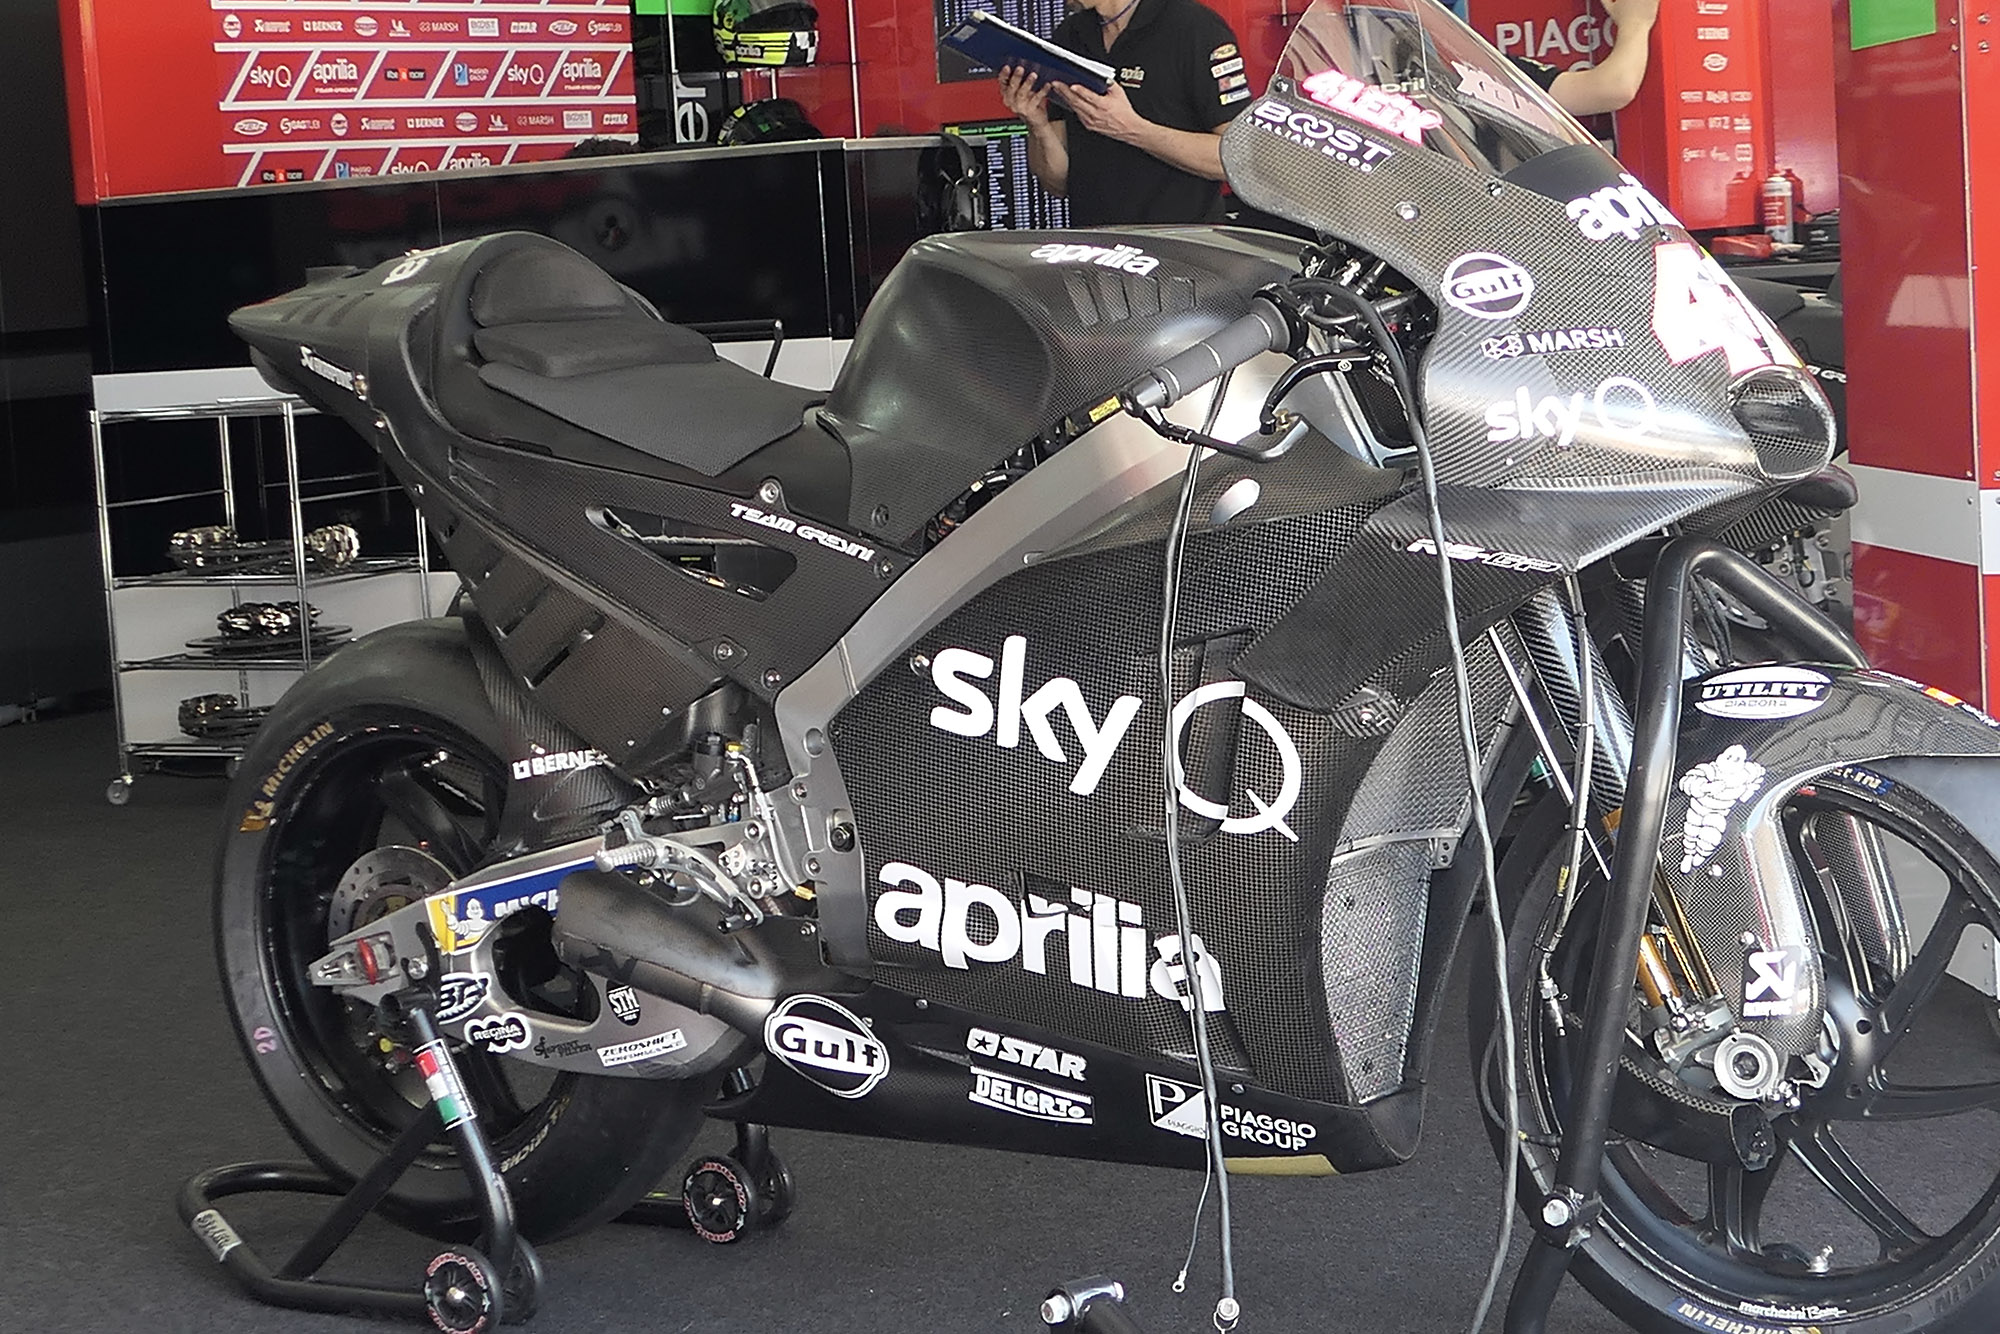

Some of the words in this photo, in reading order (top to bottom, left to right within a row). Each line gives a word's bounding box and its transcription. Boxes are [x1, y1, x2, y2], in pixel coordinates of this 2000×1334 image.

[431, 21, 459, 32] MARSH
[250, 65, 275, 88] sky
[275, 65, 292, 87] Q
[313, 58, 358, 84] aprilia
[507, 66, 529, 85] sky
[529, 64, 544, 85] Q
[562, 58, 602, 82] aprilia
[1246, 115, 1316, 148] ITALIAN
[1254, 100, 1393, 161] BOOST
[1030, 243, 1160, 277] aprilia
[1450, 273, 1524, 299] Gulf
[1527, 327, 1625, 353] MARSH
[1484, 385, 1586, 447] sky
[1593, 376, 1662, 434] Q
[730, 502, 797, 534] TEAM
[1701, 682, 1825, 699] UTILITY
[930, 634, 1143, 796] sky
[1162, 680, 1302, 842] Q
[261, 721, 335, 798] MICHELIN
[874, 861, 1227, 1012] aprilia
[774, 1022, 879, 1068] Gulf
[998, 1035, 1087, 1081] STAR
[1219, 1103, 1318, 1140] PIAGGIO
[1220, 1120, 1308, 1152] GROUP
